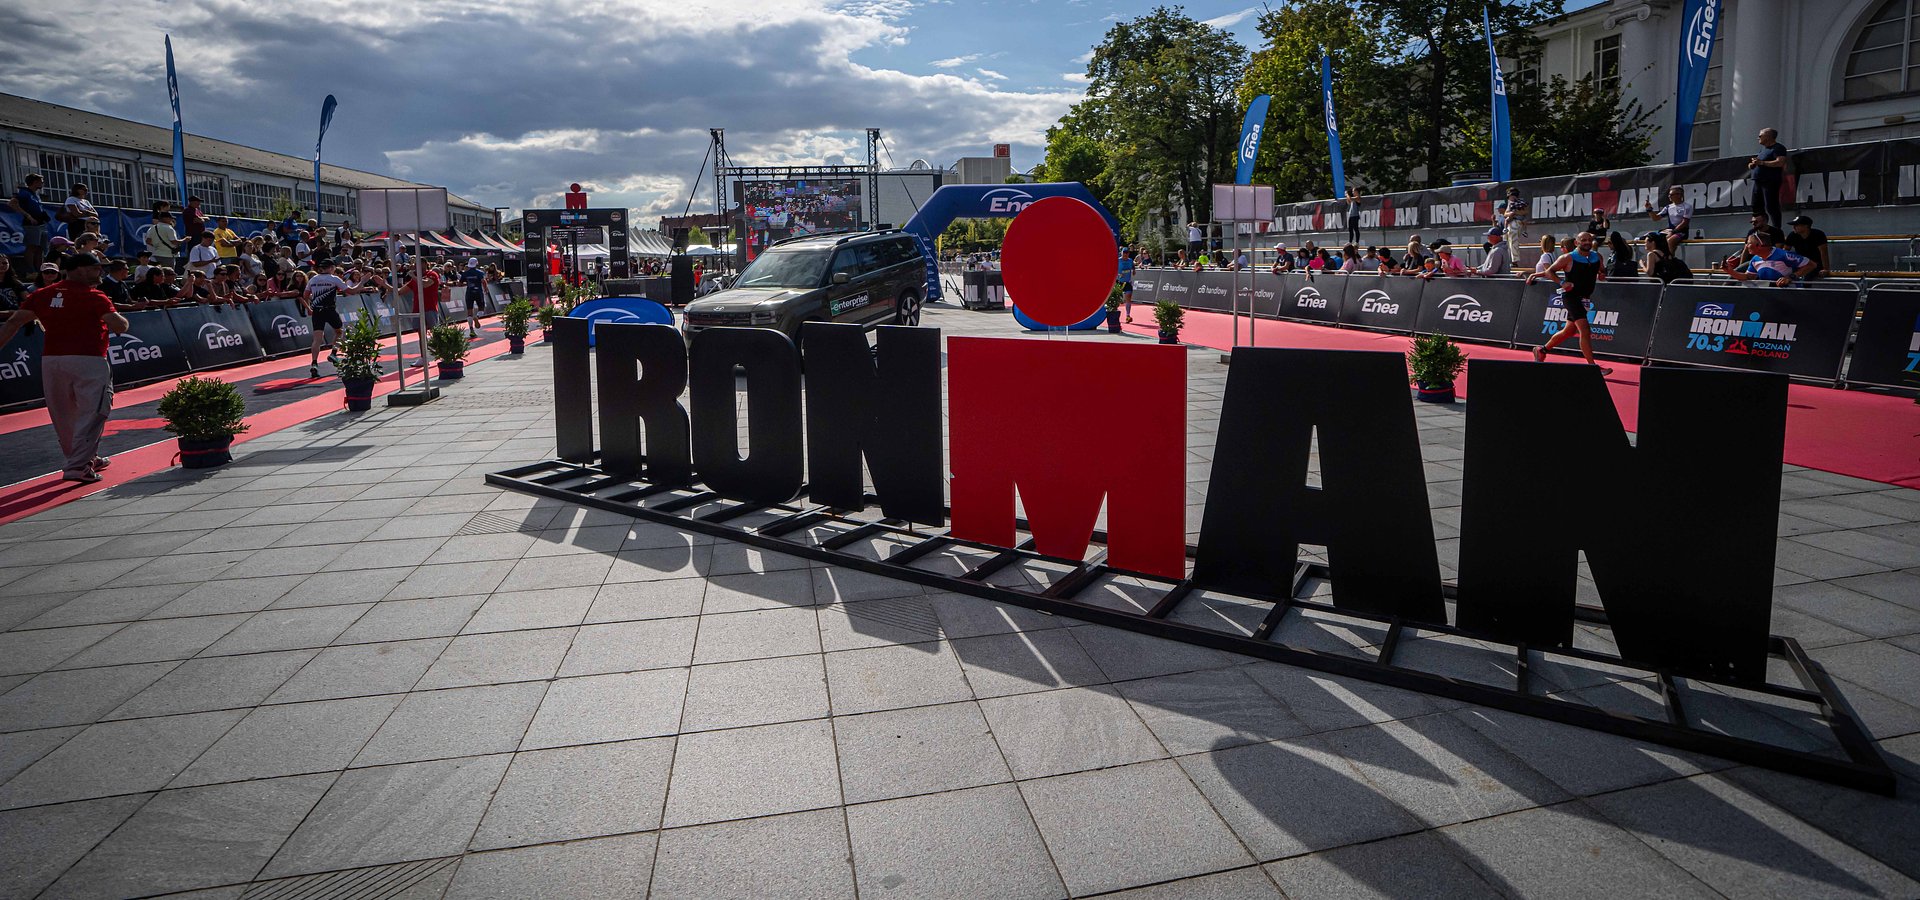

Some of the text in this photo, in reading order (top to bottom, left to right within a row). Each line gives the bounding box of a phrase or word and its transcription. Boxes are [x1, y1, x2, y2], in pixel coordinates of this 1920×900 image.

[1245, 123, 1261, 160] Enea
[1532, 178, 1659, 219] IRONMAN
[1206, 286, 1228, 297] handlowy
[832, 294, 868, 311] enterprise
[1297, 294, 1327, 309] Enea
[1362, 298, 1399, 315] Enea
[1443, 304, 1493, 323] Enea
[1702, 308, 1729, 317] Enea
[277, 322, 310, 339] Enea
[1690, 316, 1797, 341] IRONMAN
[206, 332, 244, 350] Enea
[1686, 333, 1725, 352] 70.3
[1752, 341, 1791, 352] POZNAŃ
[109, 344, 163, 365] Enea
[1750, 349, 1789, 359] POLAND
[553, 316, 1787, 684] IRONMAN
